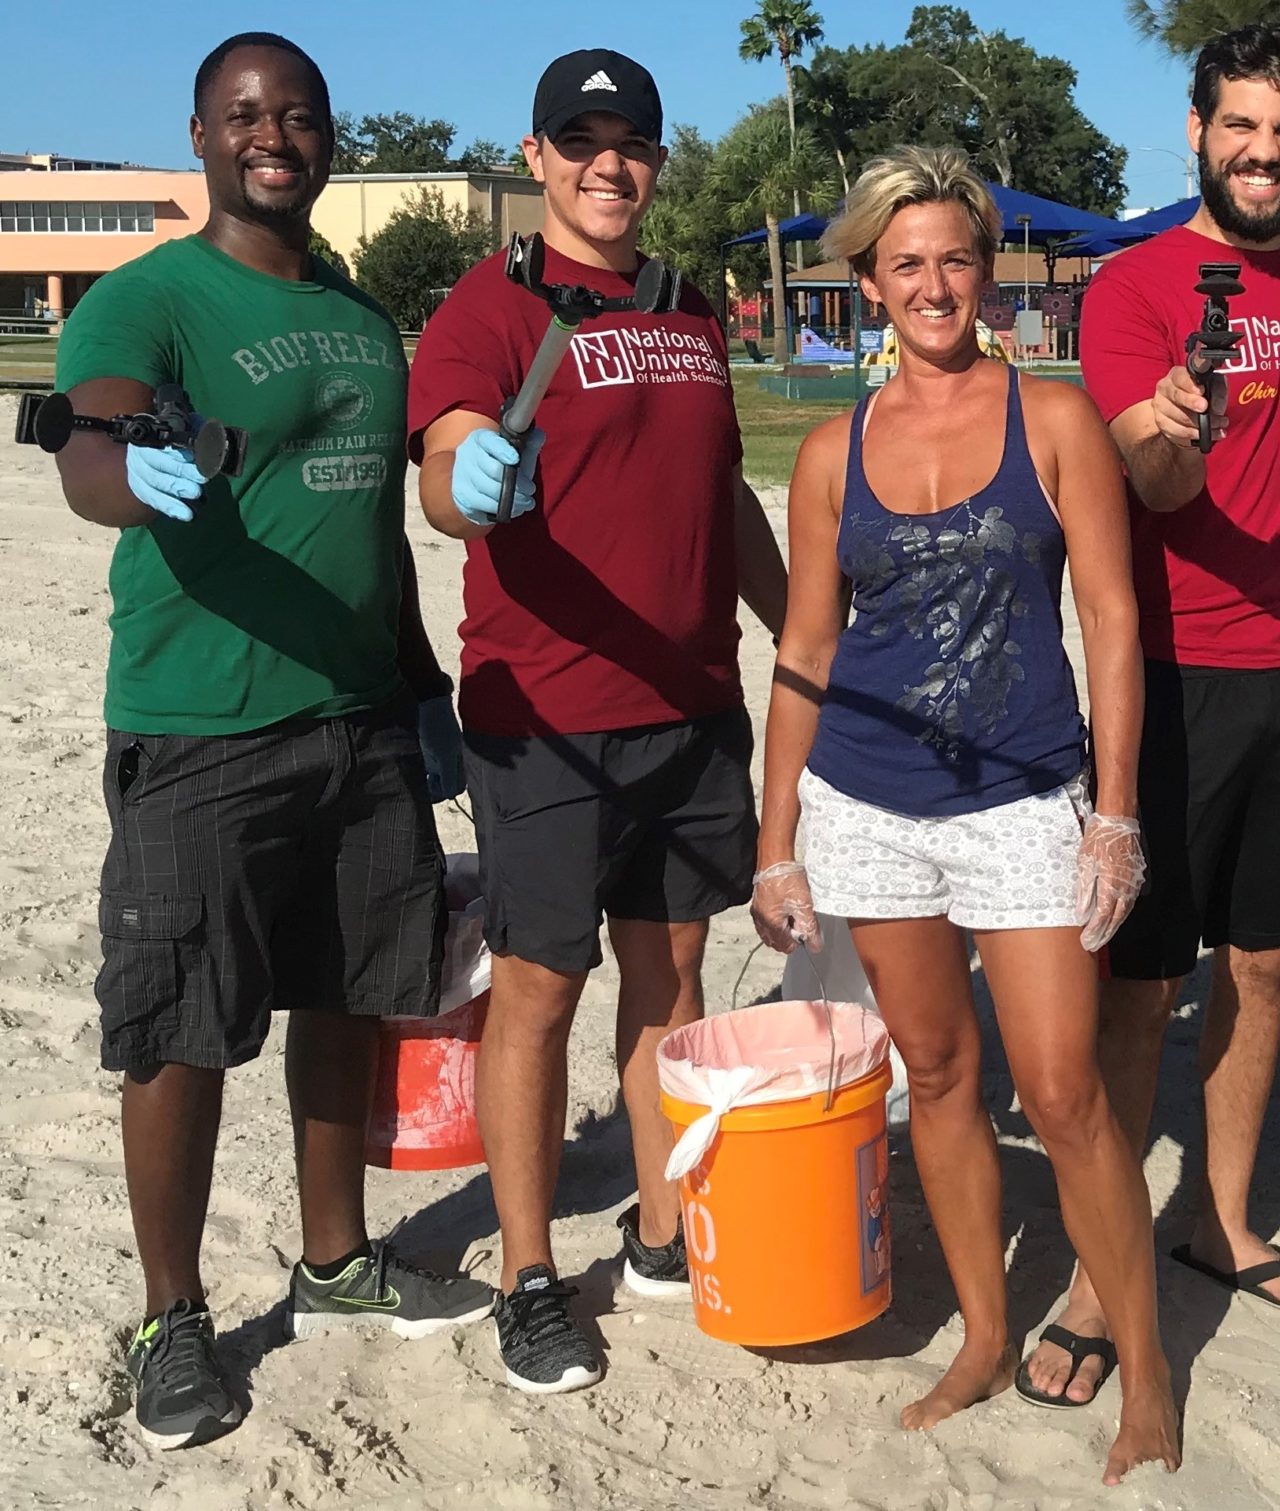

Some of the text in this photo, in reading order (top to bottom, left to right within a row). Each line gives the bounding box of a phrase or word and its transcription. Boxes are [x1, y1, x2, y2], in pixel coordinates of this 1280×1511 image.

[581, 81, 617, 92] adidas
[620, 326, 713, 355] National
[231, 331, 397, 385] BIOFREEZ
[629, 348, 728, 383] University
[1260, 360, 1272, 371] Of
[636, 370, 726, 387] Of Health Sciences
[1238, 381, 1278, 405] Chir
[336, 434, 367, 451] PAIN
[680, 1192, 717, 1264] O
